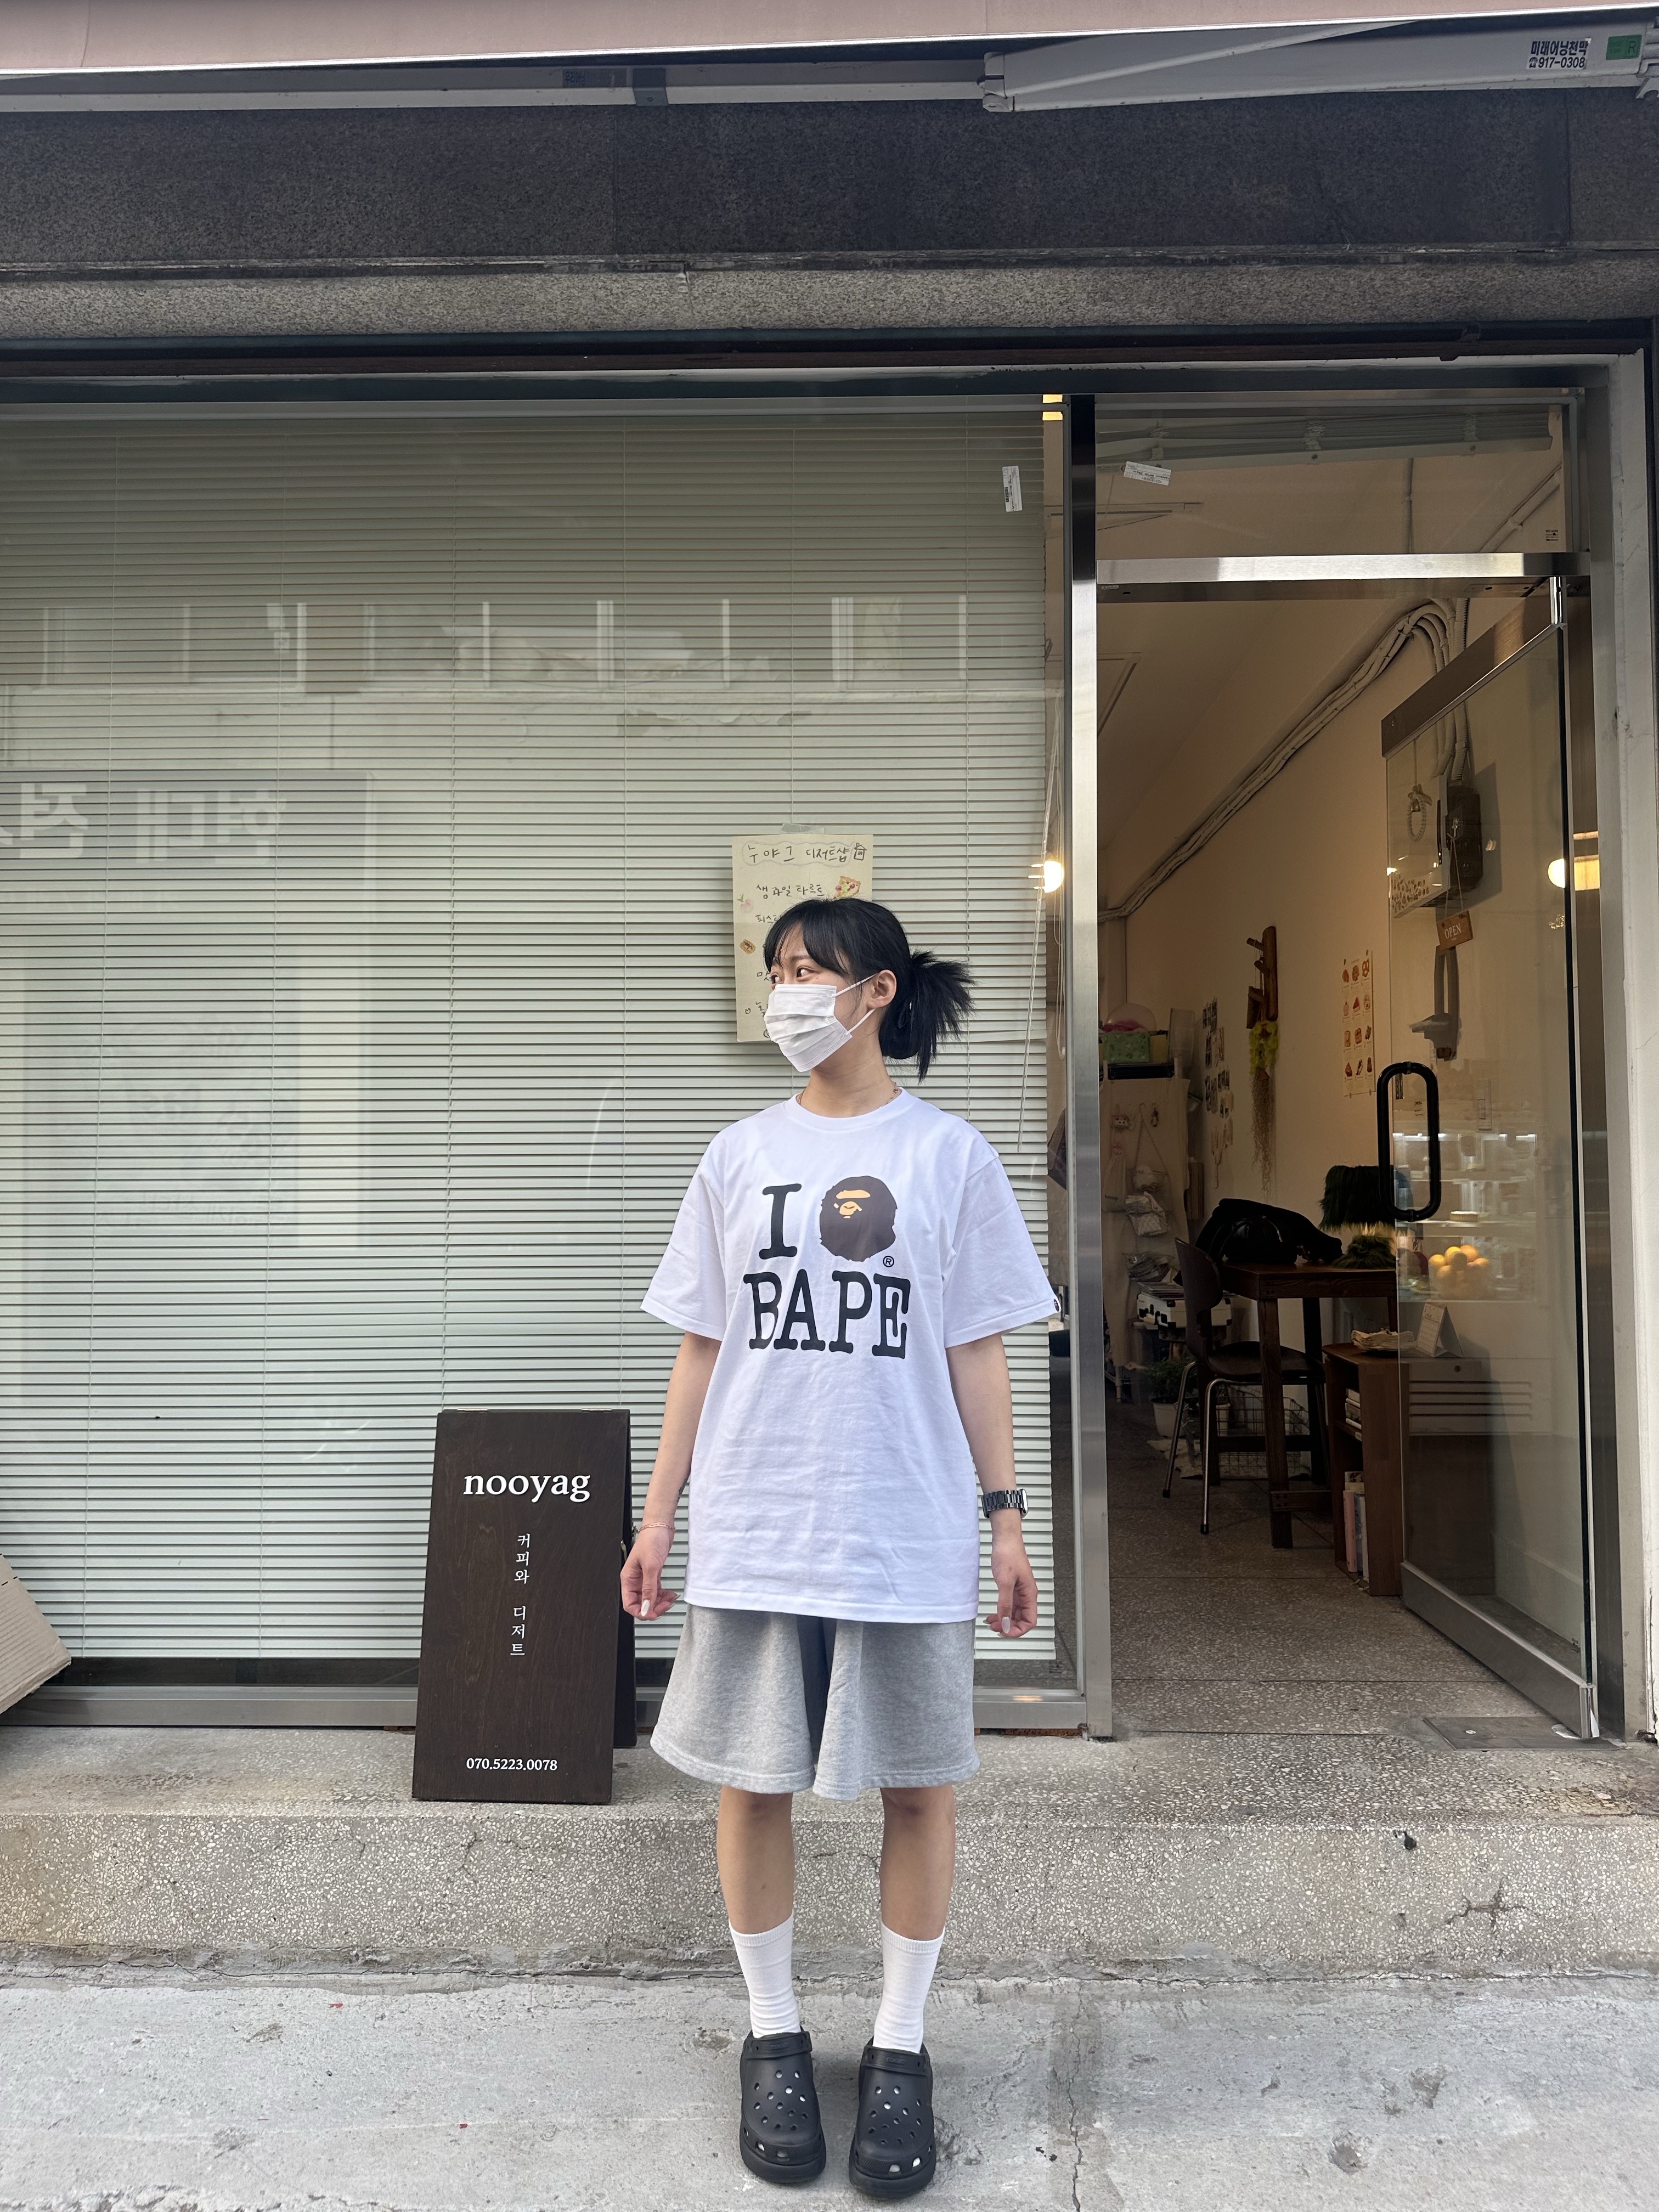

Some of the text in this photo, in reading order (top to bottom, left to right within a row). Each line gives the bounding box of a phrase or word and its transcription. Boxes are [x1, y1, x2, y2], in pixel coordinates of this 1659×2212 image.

[1531, 41, 1589, 56] 미래어닝천막
[1538, 57, 1585, 69] 917-0308
[806, 846, 850, 862] 디저트샵
[795, 884, 824, 896] 타르트
[1444, 923, 1462, 939] OPEN
[759, 1183, 802, 1260] I
[743, 1268, 911, 1359] BAPE
[463, 1474, 591, 1503] nooyag
[510, 1533, 531, 1656] 커피와 디저트
[466, 1757, 557, 1771] 070.5223.0078
